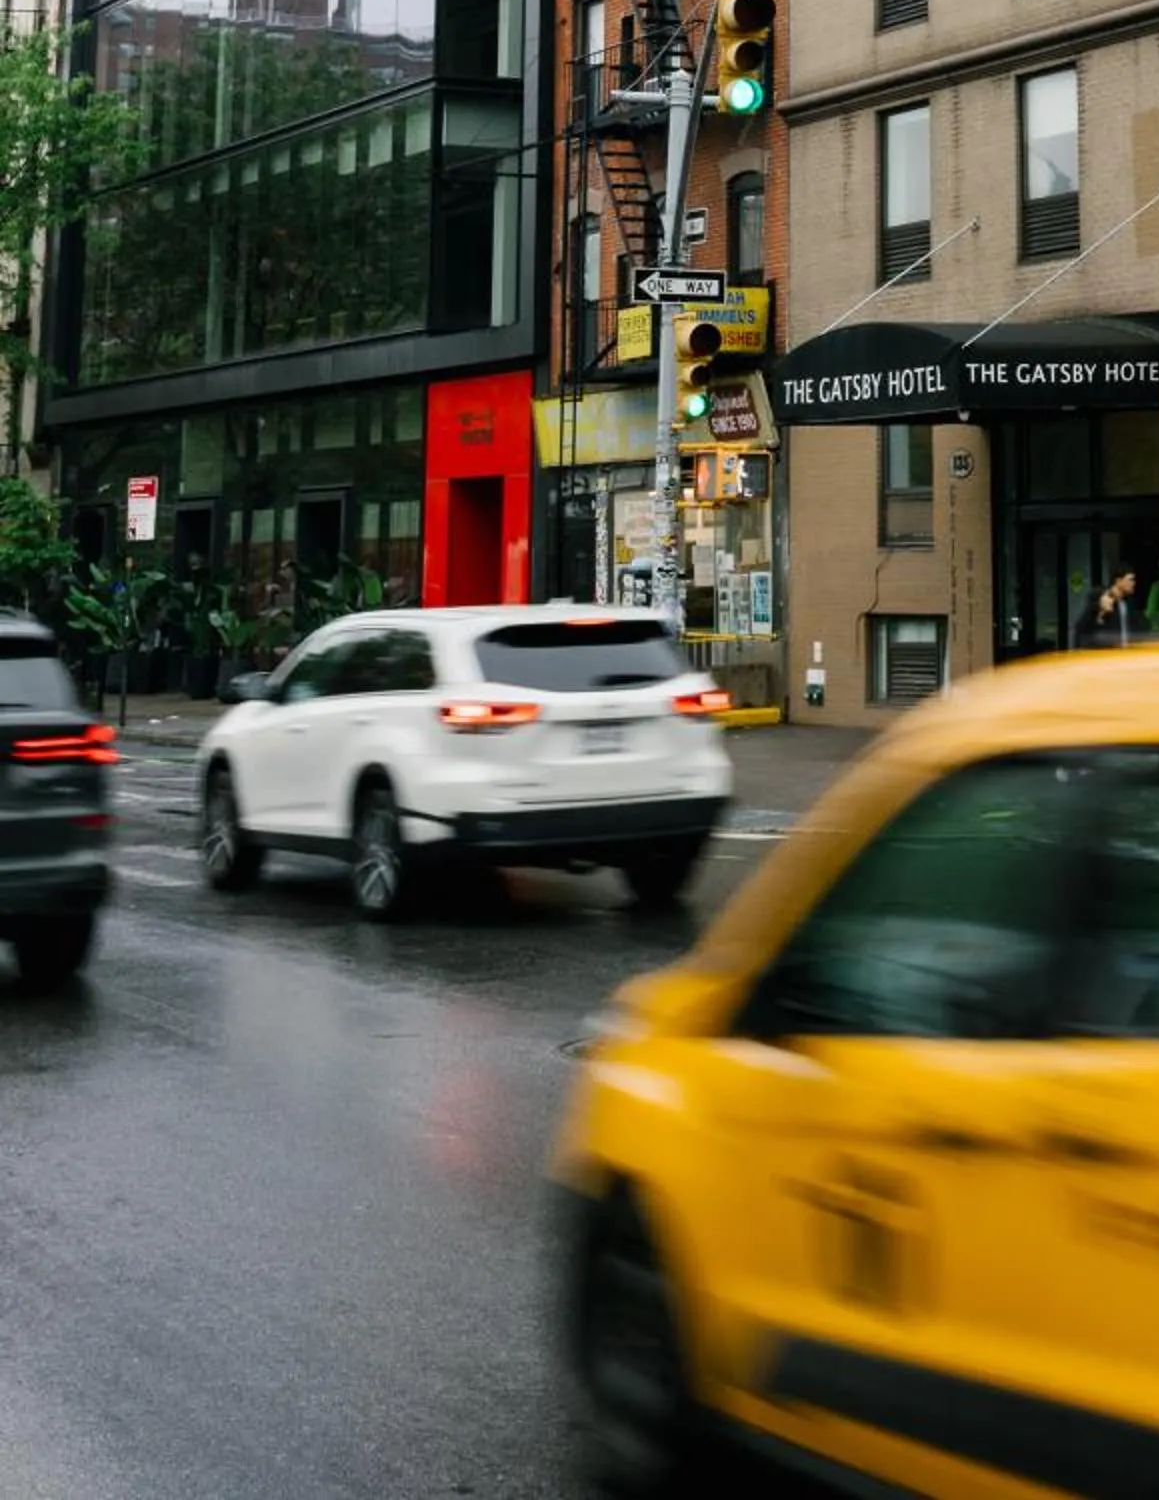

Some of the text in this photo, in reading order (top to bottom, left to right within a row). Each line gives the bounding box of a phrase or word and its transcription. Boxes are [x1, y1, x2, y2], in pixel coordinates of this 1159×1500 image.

[647, 279, 713, 293] ONE WAY
[966, 363, 1009, 383] THE
[1015, 363, 1097, 384] GATSBY
[783, 365, 946, 405] THE GATSBY HOTEL
